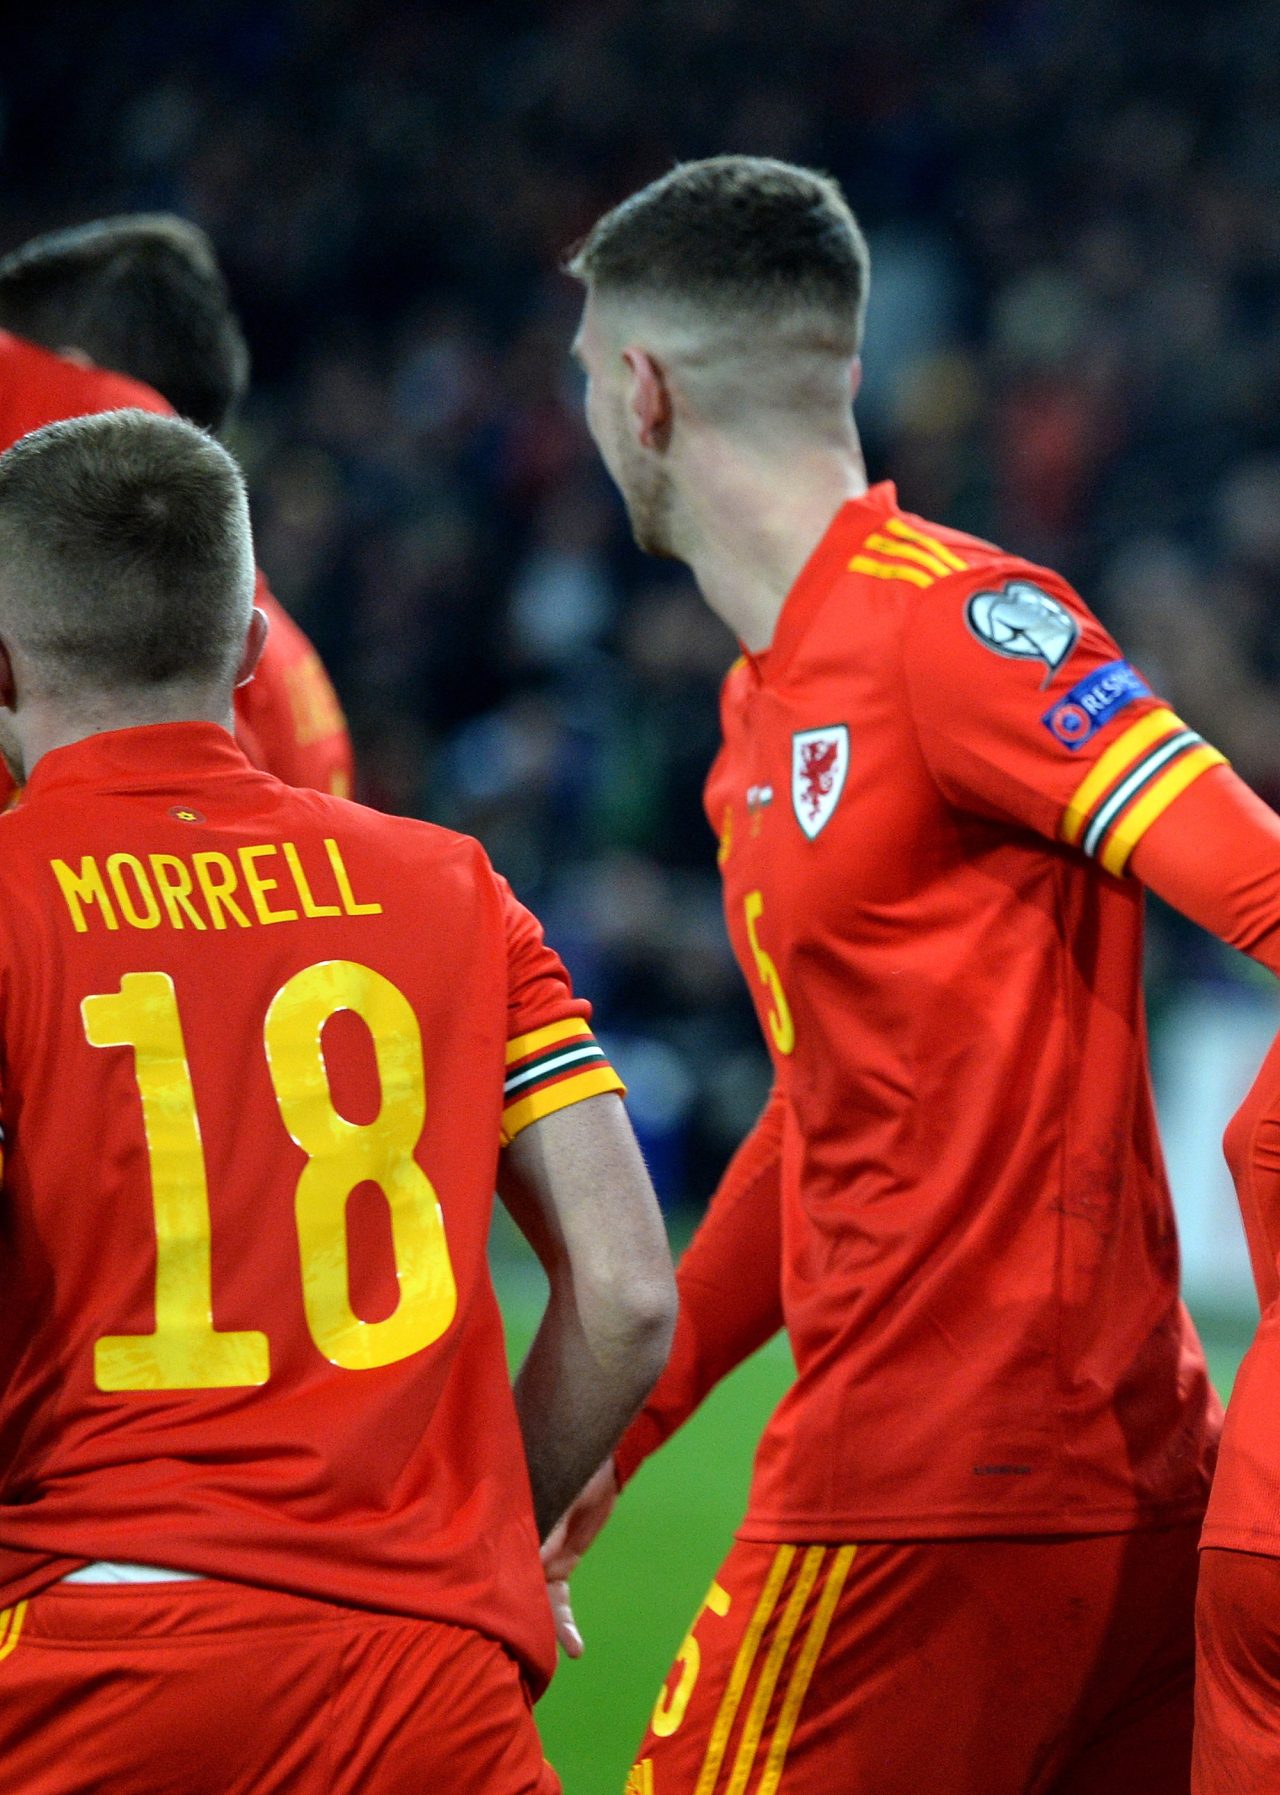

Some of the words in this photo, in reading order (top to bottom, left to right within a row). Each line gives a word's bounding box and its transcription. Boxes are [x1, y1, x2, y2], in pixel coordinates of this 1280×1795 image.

[51, 838, 383, 933] MORRELL
[745, 891, 794, 1055] 5
[80, 959, 457, 1392] 18
